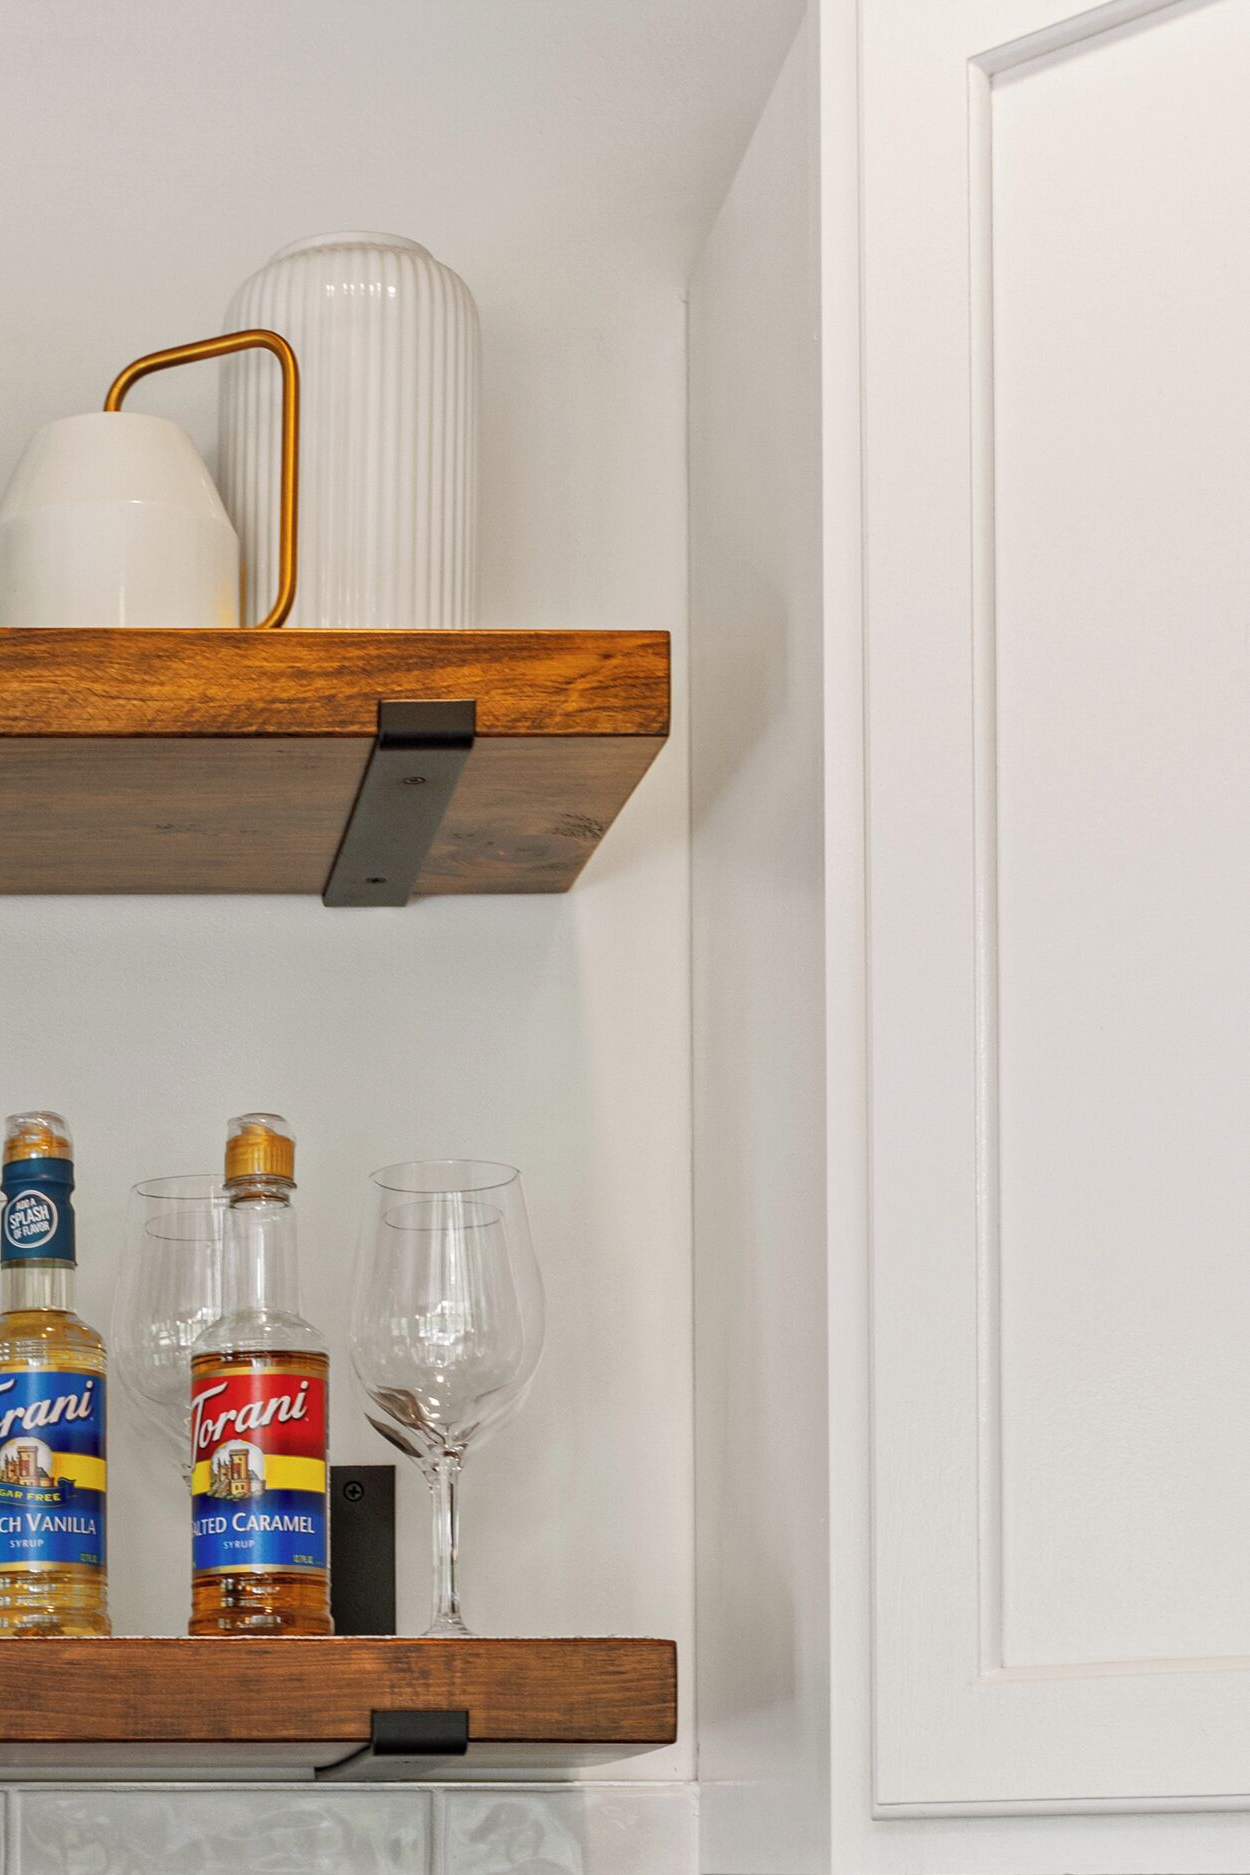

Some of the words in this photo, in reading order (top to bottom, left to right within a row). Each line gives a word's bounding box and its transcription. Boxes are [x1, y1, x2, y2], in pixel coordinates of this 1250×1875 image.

[10, 1205, 50, 1229] SPLASH
[13, 1228, 23, 1240] OF
[22, 1220, 50, 1236] FLAVOR
[191, 1380, 309, 1472] Torani
[26, 1491, 62, 1502] FREE
[25, 1512, 97, 1536] VANILLA
[192, 1516, 228, 1537] ALTED
[231, 1511, 316, 1534] CARAMEL
[9, 1538, 45, 1549] SYRUP
[222, 1539, 255, 1550] SYRUP
